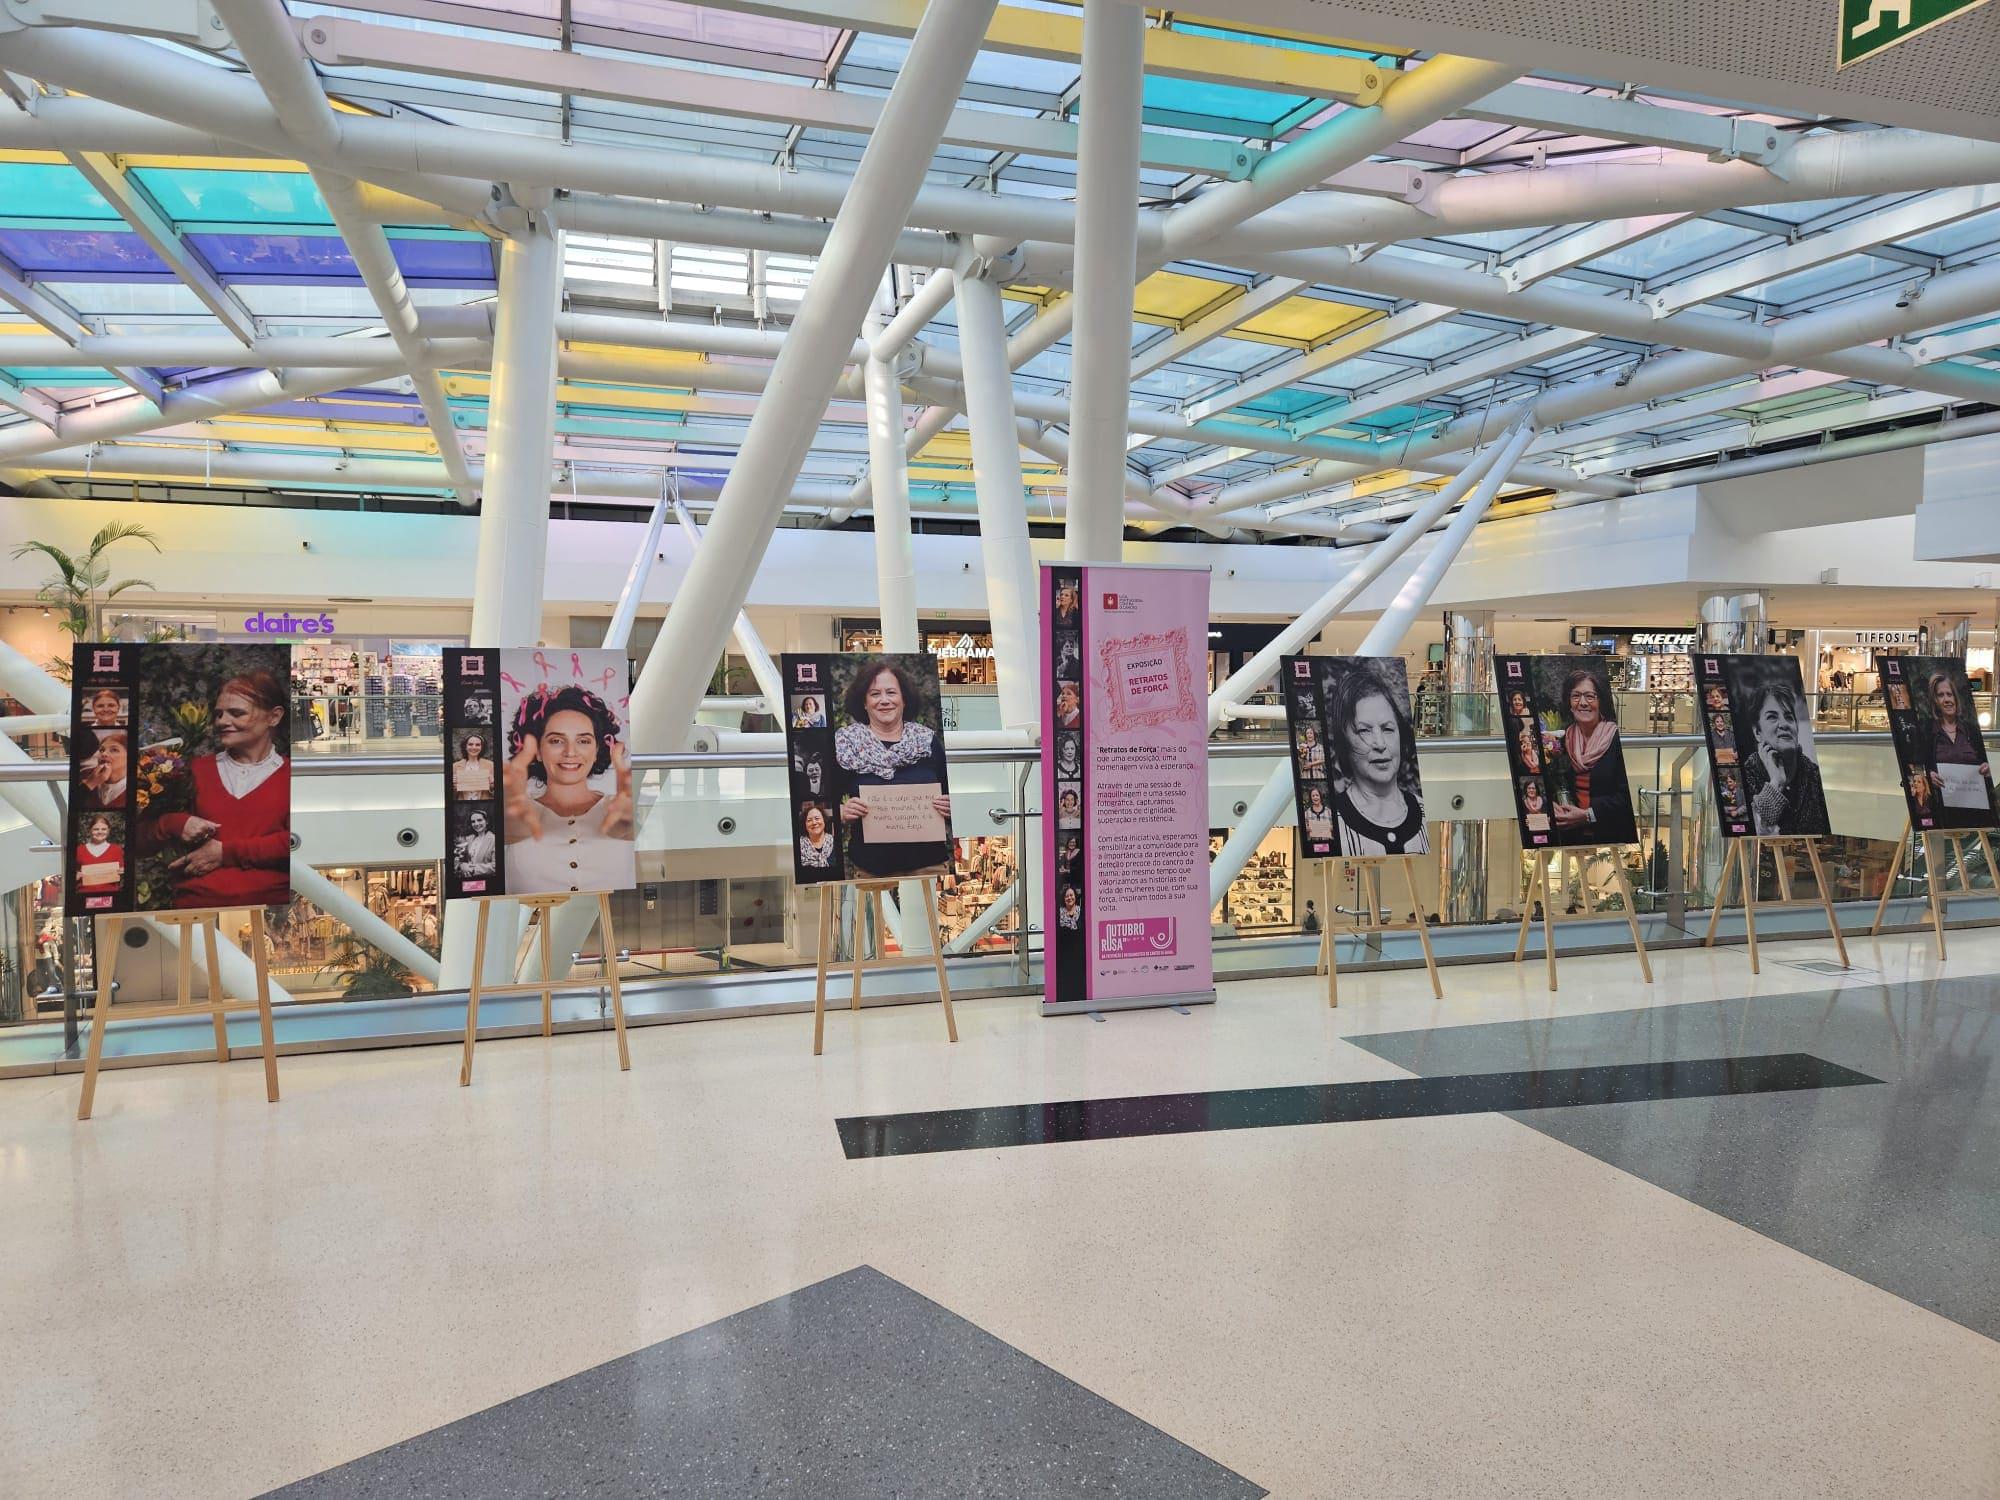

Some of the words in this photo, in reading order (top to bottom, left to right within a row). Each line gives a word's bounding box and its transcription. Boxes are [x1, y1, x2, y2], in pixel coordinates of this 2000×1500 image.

[244, 609, 335, 634] claire's
[1856, 632, 1905, 643] TIFFOSI
[1127, 658, 1163, 670] EXPOSIÇÃO
[1128, 673, 1169, 686] RETRATOS
[1143, 683, 1169, 694] FORÇA
[1178, 745, 1187, 753] do
[1096, 764, 1138, 772] homenagem
[1097, 791, 1142, 800] maquilhagem
[1097, 817, 1132, 825] superação
[1162, 833, 1198, 841] esperamos
[1142, 842, 1182, 850] comunidade
[1183, 842, 1199, 850] para
[1104, 851, 1143, 861] importância
[1154, 850, 1188, 860] prevenção
[1098, 861, 1125, 870] deteção
[1125, 861, 1152, 869] precoce
[1162, 859, 1184, 867] cancro
[1156, 868, 1178, 876] tempo
[1178, 867, 1192, 875] que
[1098, 878, 1139, 887] valorizamos
[1148, 876, 1177, 884] histórias
[1178, 875, 1188, 883] de
[1114, 886, 1124, 894] de
[1118, 894, 1149, 903] inspiram
[1106, 923, 1145, 938] OUTUBRO
